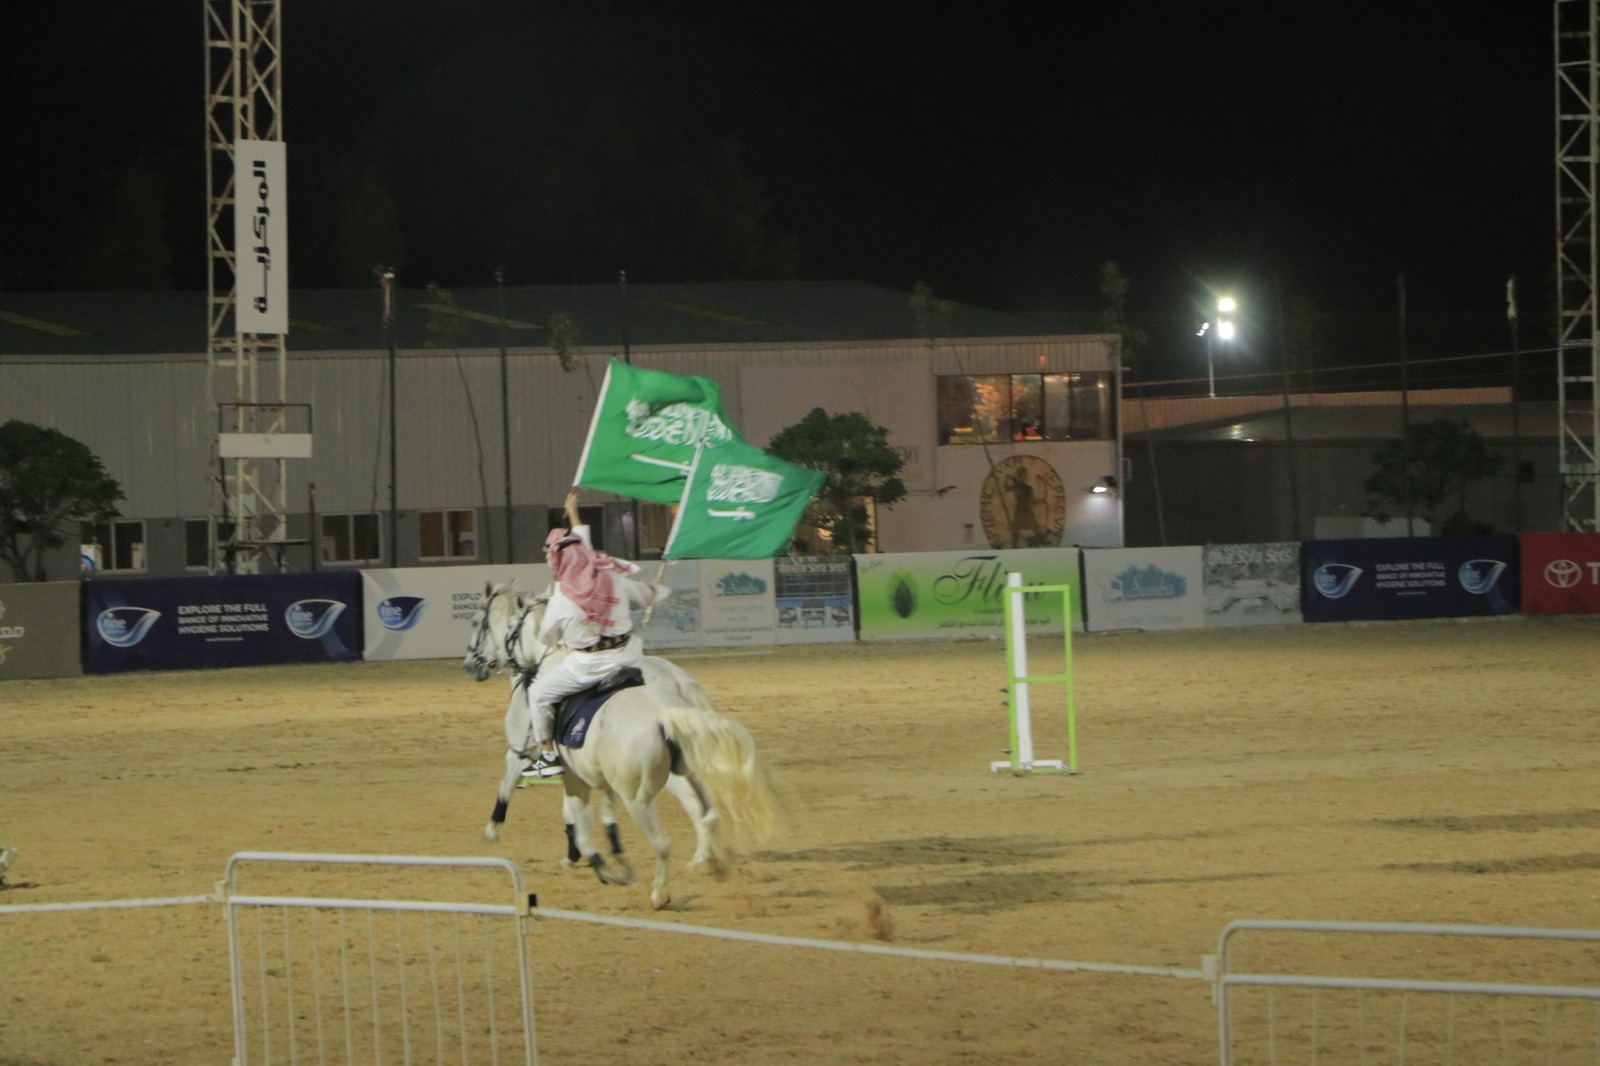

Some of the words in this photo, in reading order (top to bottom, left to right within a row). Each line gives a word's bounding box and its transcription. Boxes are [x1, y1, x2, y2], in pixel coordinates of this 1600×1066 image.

[452, 592, 481, 601] EXPLO
[177, 604, 222, 614] EXPLORE
[223, 603, 242, 613] THE
[243, 602, 268, 612] FULL
[177, 615, 207, 624] RANGE
[207, 615, 219, 623] OF
[220, 614, 268, 623] INNOVATIVE
[178, 624, 218, 634] HYGIENE
[219, 623, 269, 633] SOLUTIONS
